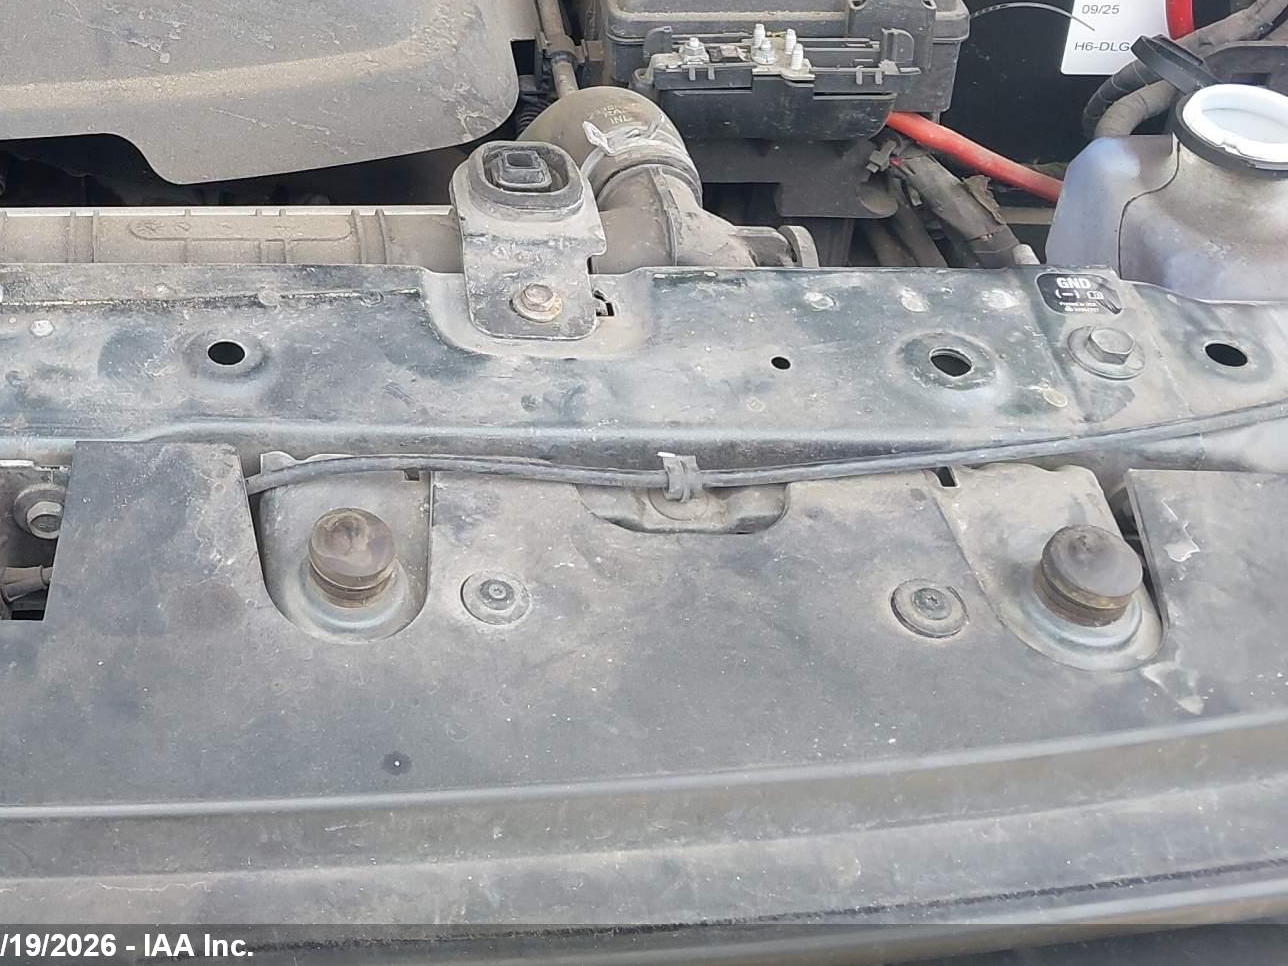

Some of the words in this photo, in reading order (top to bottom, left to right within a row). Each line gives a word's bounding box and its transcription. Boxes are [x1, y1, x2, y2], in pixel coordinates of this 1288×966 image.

[1081, 4, 1120, 15] 09/25
[1074, 41, 1130, 52] H6-DLG
[1056, 277, 1091, 289] GND
